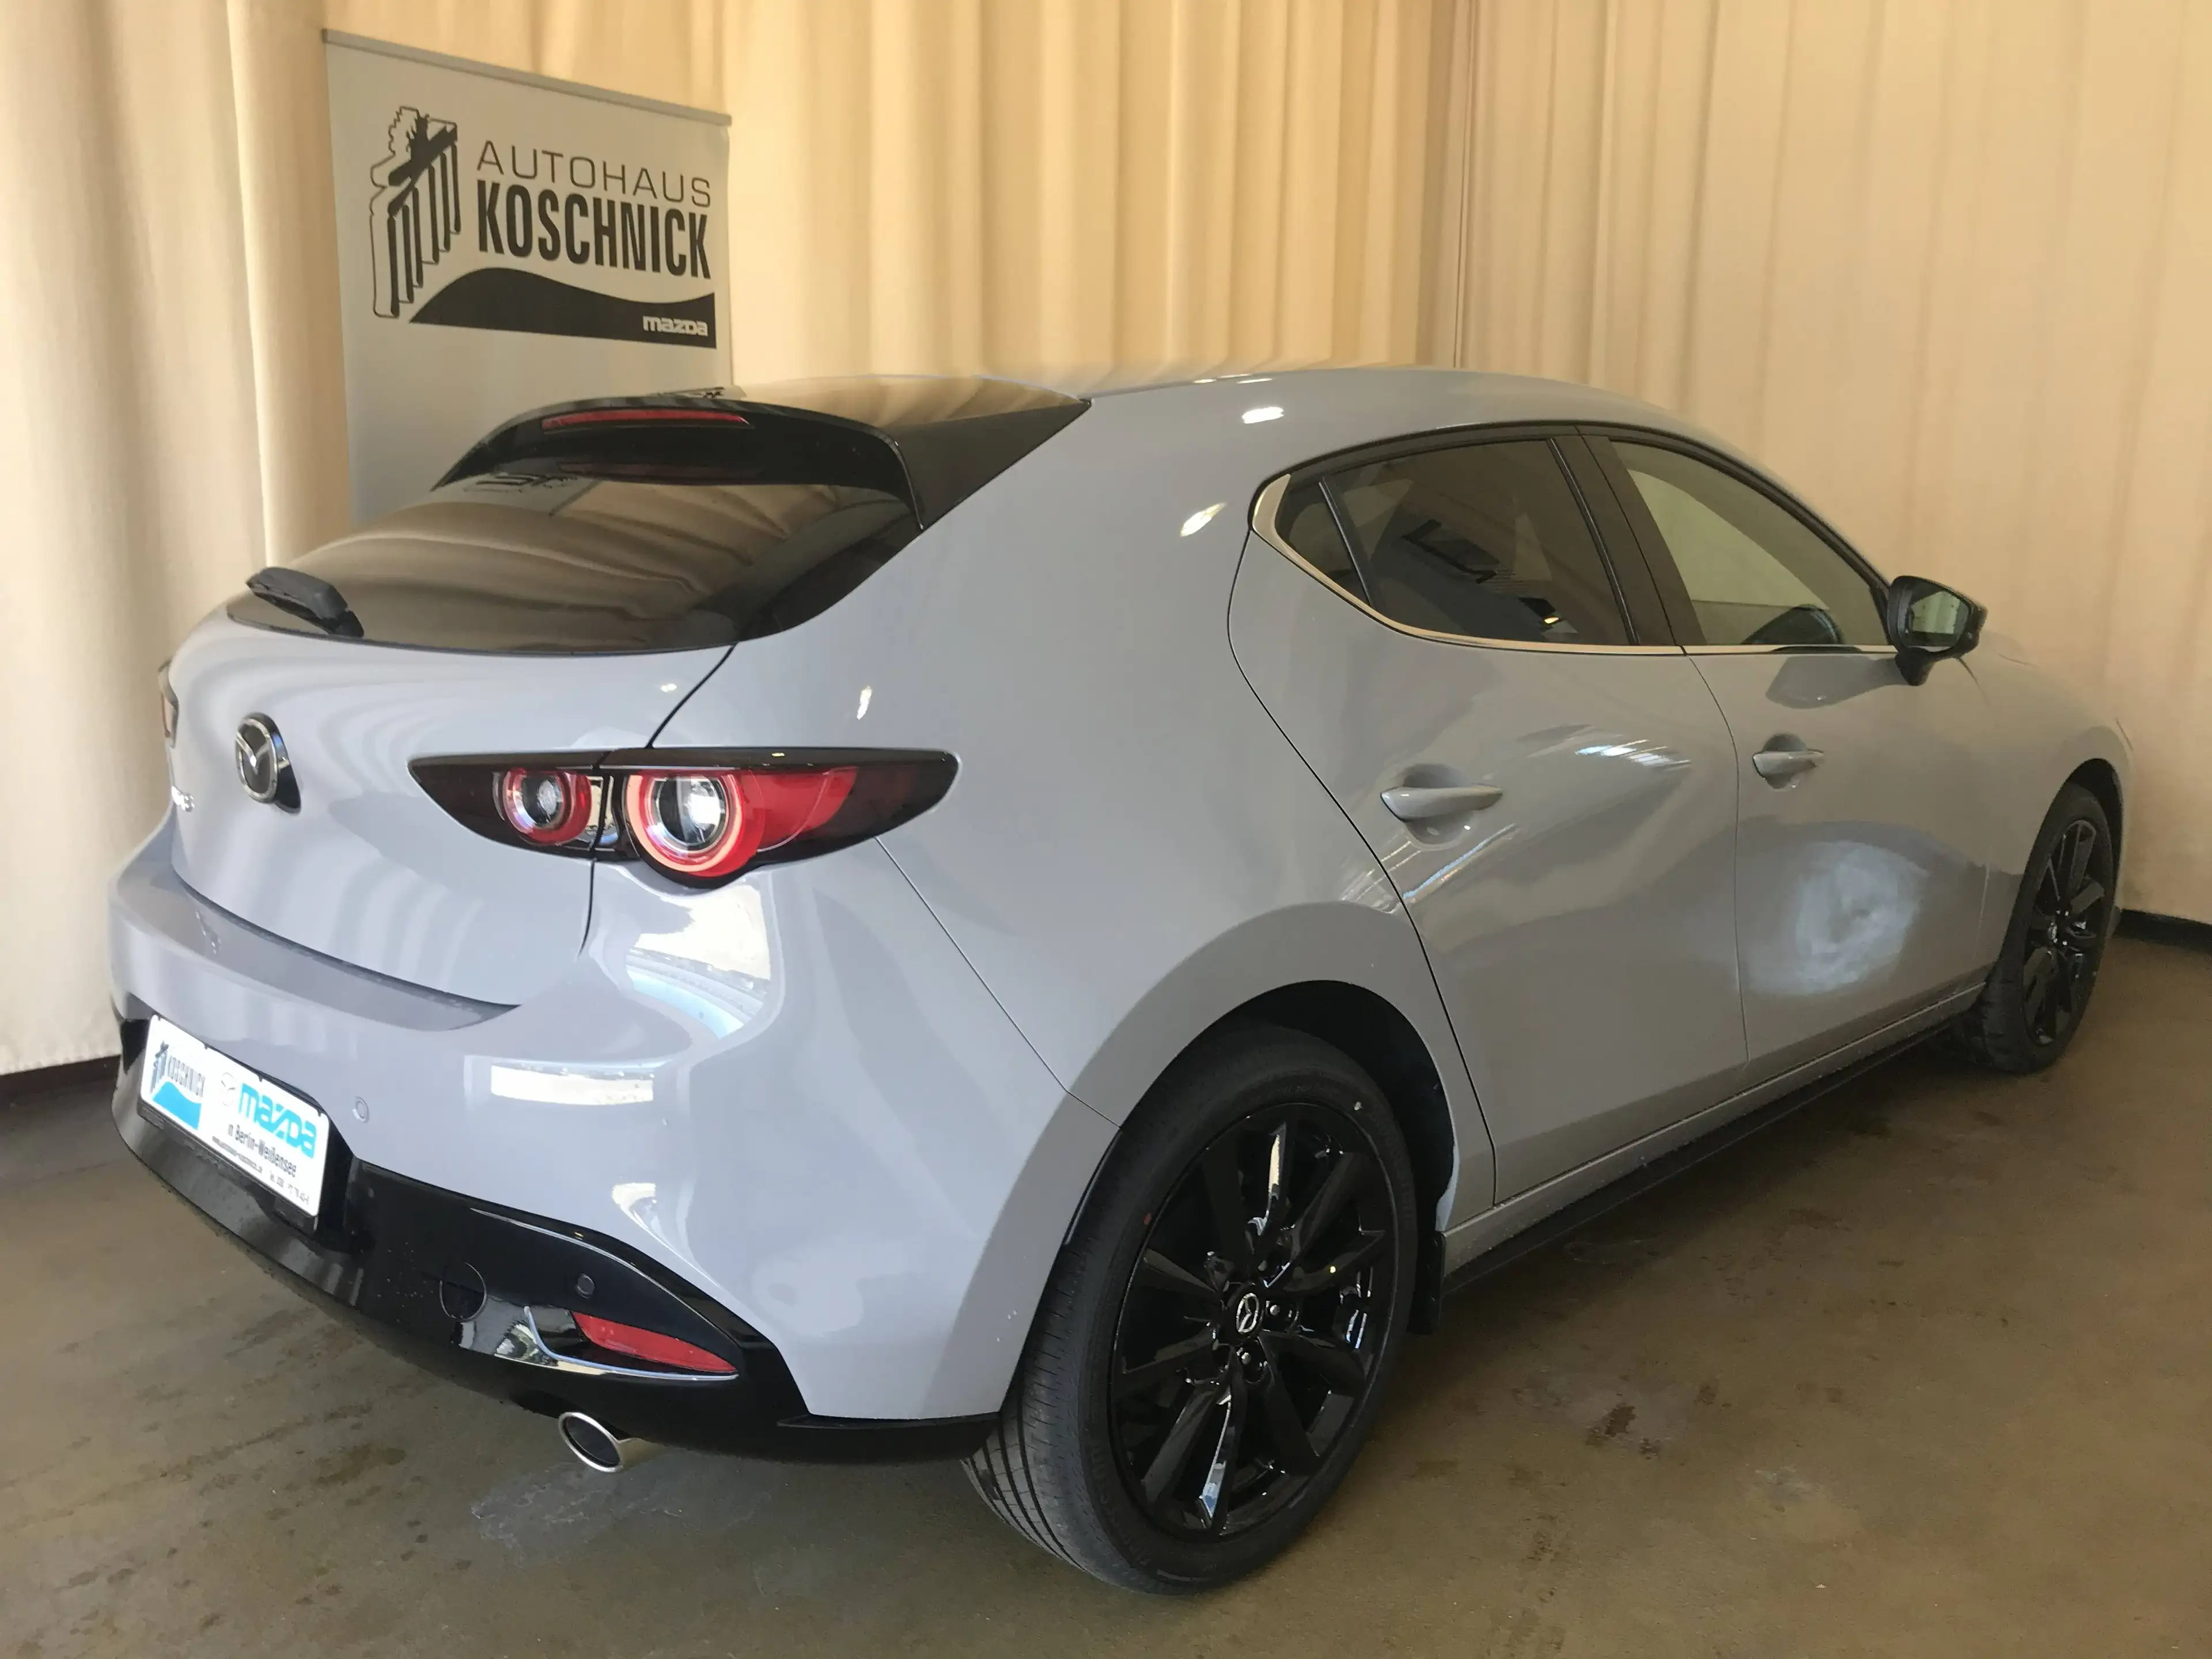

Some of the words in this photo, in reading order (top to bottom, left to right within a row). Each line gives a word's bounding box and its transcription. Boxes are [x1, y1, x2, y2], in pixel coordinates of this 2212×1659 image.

[476, 140, 711, 209] AUTOHAUS
[476, 180, 711, 280] KOSCHNICK
[642, 315, 709, 337] mazda
[238, 1082, 317, 1160] mazda
